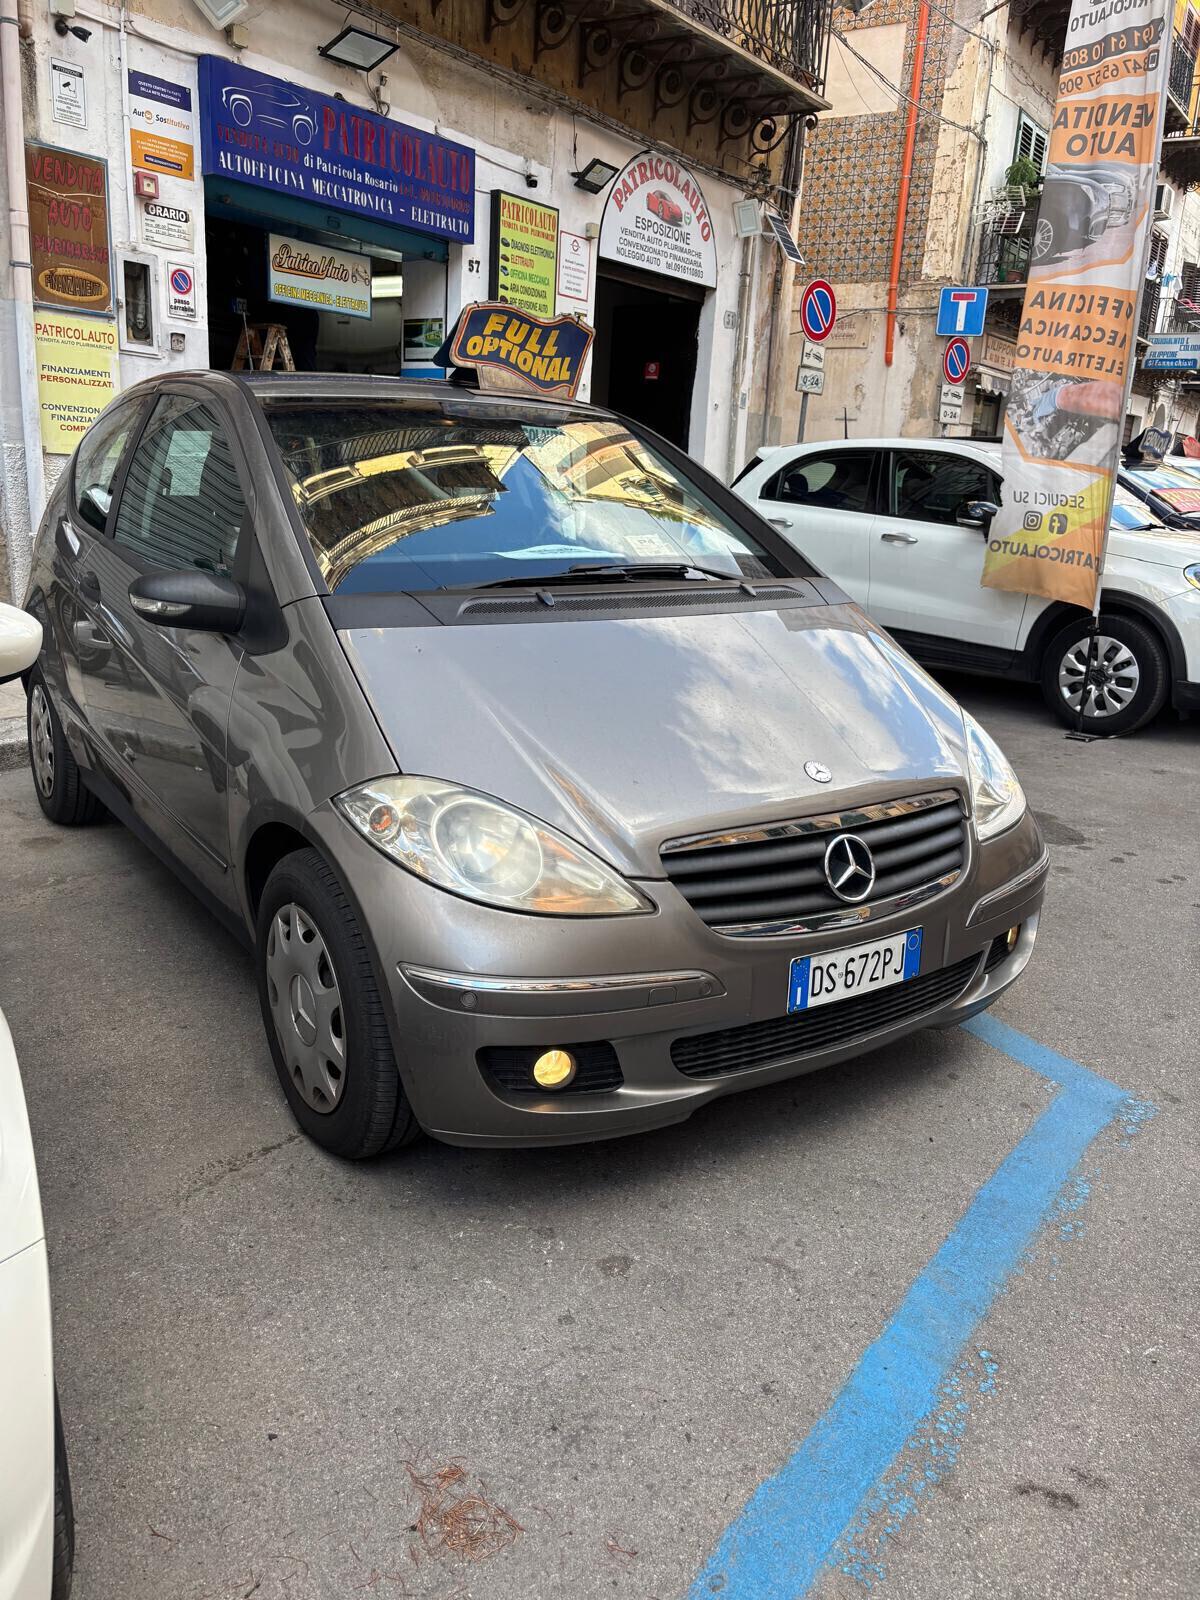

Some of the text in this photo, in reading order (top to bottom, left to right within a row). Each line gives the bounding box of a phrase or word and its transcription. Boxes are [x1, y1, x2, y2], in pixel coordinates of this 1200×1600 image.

[155, 114, 190, 130] Sostitutiva
[322, 104, 471, 195] PATRICOLAUTO
[32, 153, 104, 193] VENDITA
[304, 153, 314, 169] di
[317, 156, 362, 183] Patricola
[364, 171, 398, 194] Rosario
[219, 150, 305, 190] AUTOFFICINA
[312, 177, 393, 215] MECCATRONICA
[411, 206, 469, 236] ELETTRAUTO
[611, 158, 711, 242] PATRICOLAUTO
[49, 199, 92, 232] AUTO
[149, 204, 186, 222] ORARIO
[501, 199, 556, 232] PATRICOLAUTO
[635, 215, 691, 246] ESPOSIZIONE
[511, 239, 555, 260] DIAGNOSI ELETTRONICA
[618, 236, 703, 269] CONVENZIONATO FINANZIARIA
[620, 226, 703, 260] VENDITA AUTO PLURIMARCHE
[468, 259, 481, 273] 57
[616, 246, 646, 262] NOLEGGIO
[646, 254, 661, 267] AUTO
[510, 268, 528, 281] OFFICINA
[528, 272, 550, 287] MECCANICA
[274, 282, 300, 300] OFFICINA
[300, 287, 333, 305] MECCANICA
[335, 295, 368, 312] ELETTRAUTO
[510, 282, 547, 299] ARIA CONDIZIONATA
[170, 304, 194, 314] carrabile
[173, 298, 190, 306] passo
[538, 302, 549, 314] AUTO
[35, 322, 115, 345] PATRICOLAUTO
[36, 336, 60, 345] VENDITA
[75, 341, 113, 351] PLURIMARCHE
[482, 312, 560, 357] FULL
[466, 335, 571, 381] OPTIONAL
[40, 374, 115, 389] PERSONALIZZATI
[41, 364, 111, 379] FINANZIAMENTI
[802, 374, 819, 386] 0-24
[41, 403, 101, 414] CONVENZION
[51, 413, 96, 423] FINANZIA
[943, 410, 957, 419] 0-24
